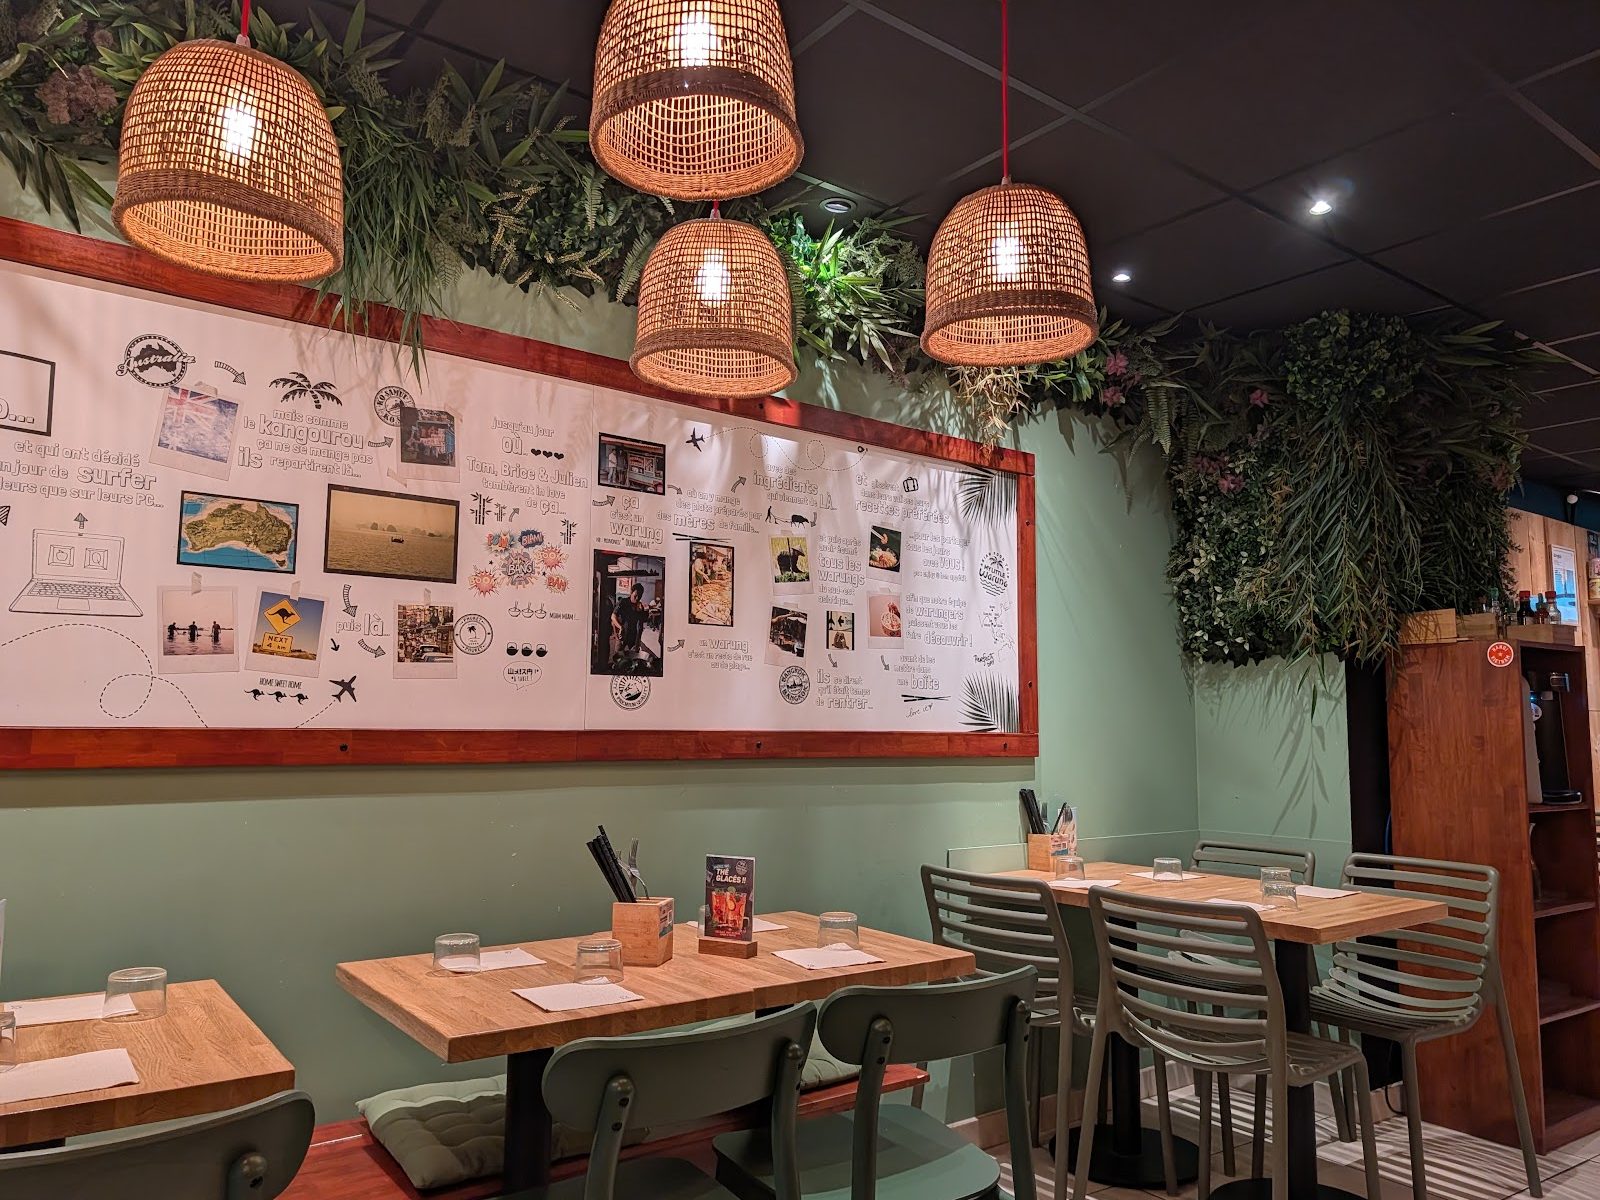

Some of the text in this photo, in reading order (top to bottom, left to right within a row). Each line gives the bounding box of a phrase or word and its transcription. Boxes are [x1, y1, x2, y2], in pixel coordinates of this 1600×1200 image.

[116, 352, 196, 376] Australia
[376, 388, 410, 406] KO SAMUI
[273, 409, 349, 430] mais comme
[383, 413, 395, 423] KO
[243, 414, 364, 449] le kangourou
[491, 417, 554, 438] jusqu'au jour
[14, 440, 140, 468] et qui ont décidé
[238, 446, 263, 469] ils
[270, 456, 340, 474] repartirent
[256, 439, 374, 465] ça ne se mange pas
[11, 459, 47, 476] jour
[49, 465, 69, 479] de
[77, 466, 157, 490] surfer
[466, 455, 588, 488] Tom, Brice & Julien
[856, 472, 868, 486] et
[482, 478, 566, 499] tombèrent in love
[753, 470, 819, 496] ingrédients
[40, 484, 67, 499] que
[70, 487, 95, 500] sur
[97, 488, 133, 505] leurs
[525, 497, 537, 508] de
[621, 494, 640, 511] ça
[610, 510, 645, 524] c'est un
[656, 510, 672, 521] des
[673, 511, 715, 531] mères
[676, 501, 762, 522] des plats préparés par
[855, 500, 950, 524] recettes préférées
[610, 522, 664, 545] warung
[508, 560, 536, 576] BANG!
[818, 552, 862, 572] tous les
[817, 570, 866, 588] warungs
[335, 619, 362, 633] puis
[268, 635, 289, 643] NEXT
[924, 631, 968, 647] découvrir
[1491, 655, 1510, 664] VIETNAM
[259, 678, 302, 689] HOME SWEET HOME
[781, 667, 808, 683] BANGKOK
[817, 669, 830, 684] ils
[911, 674, 940, 690] boîte
[782, 686, 809, 701] BANGKOK
[716, 867, 729, 875] THÉ
[716, 873, 741, 883] GLACÉS
